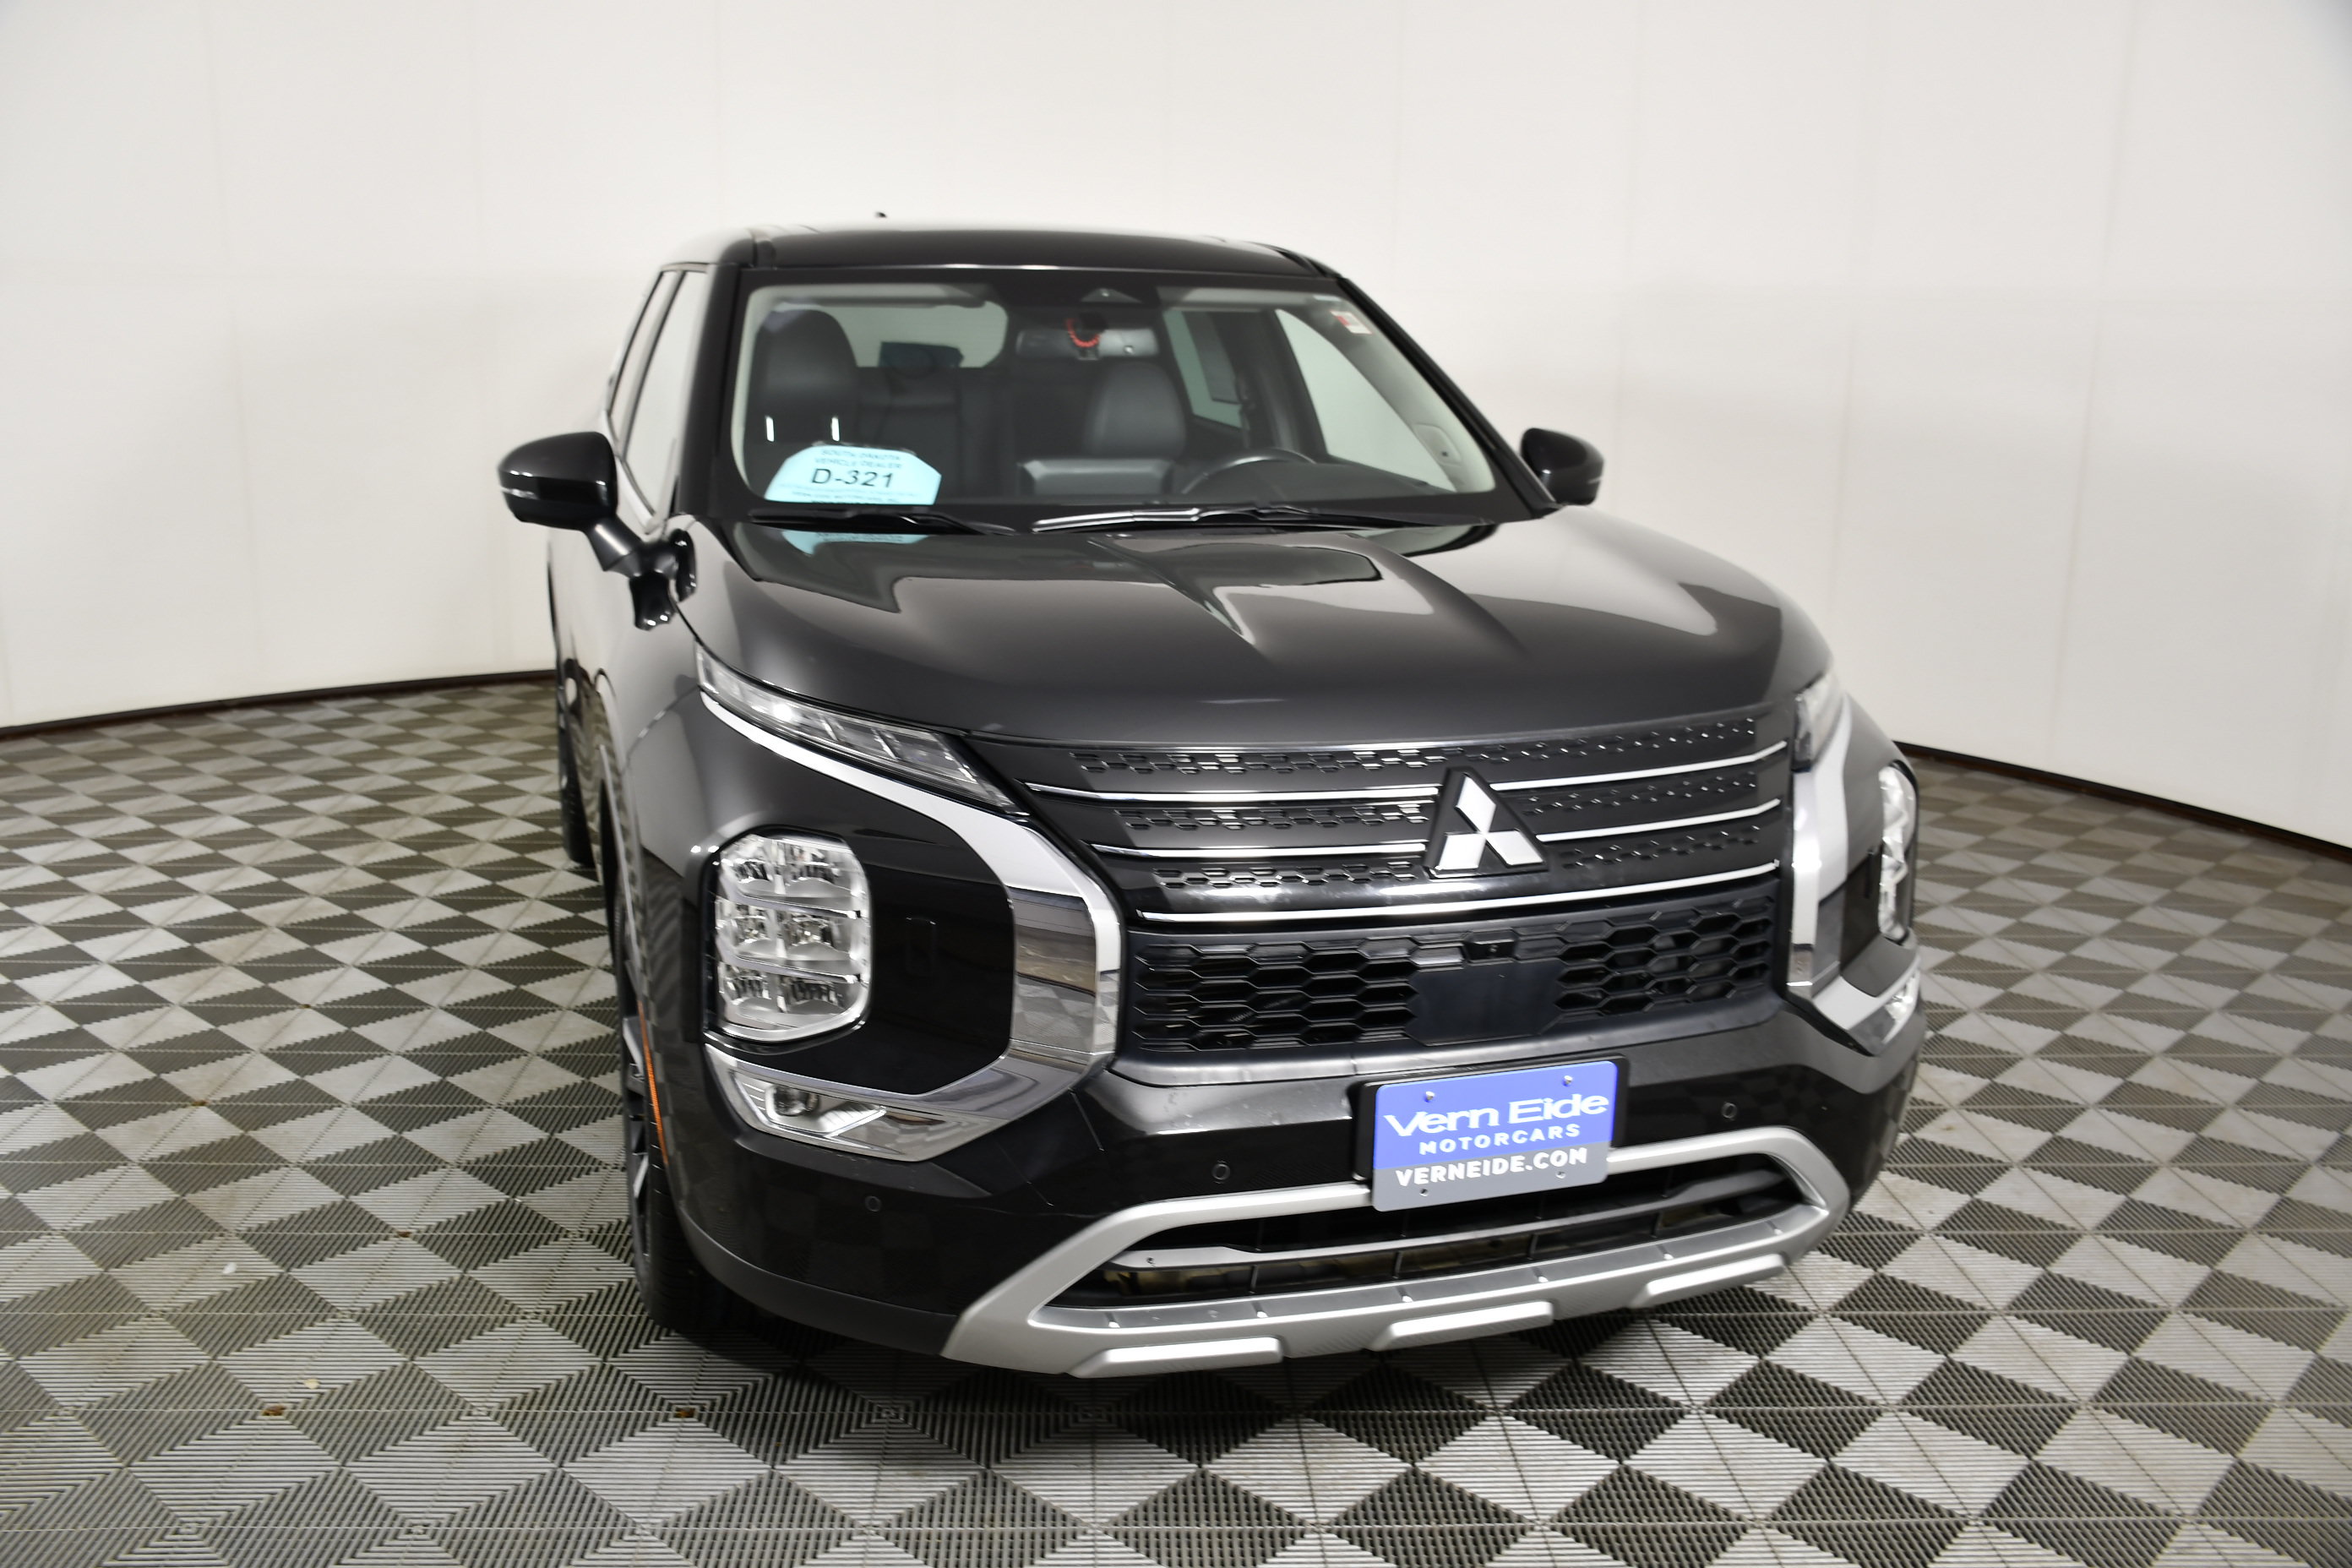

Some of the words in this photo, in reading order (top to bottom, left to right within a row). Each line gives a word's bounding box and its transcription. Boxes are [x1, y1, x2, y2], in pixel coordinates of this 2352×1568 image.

[811, 468, 894, 487] D-321
[1383, 1106, 1500, 1136] Vern
[1508, 1093, 1609, 1124] Eide
[1419, 1123, 1581, 1156] MOTORCARS
[1395, 1146, 1587, 1187] VERNEIDE.COM
